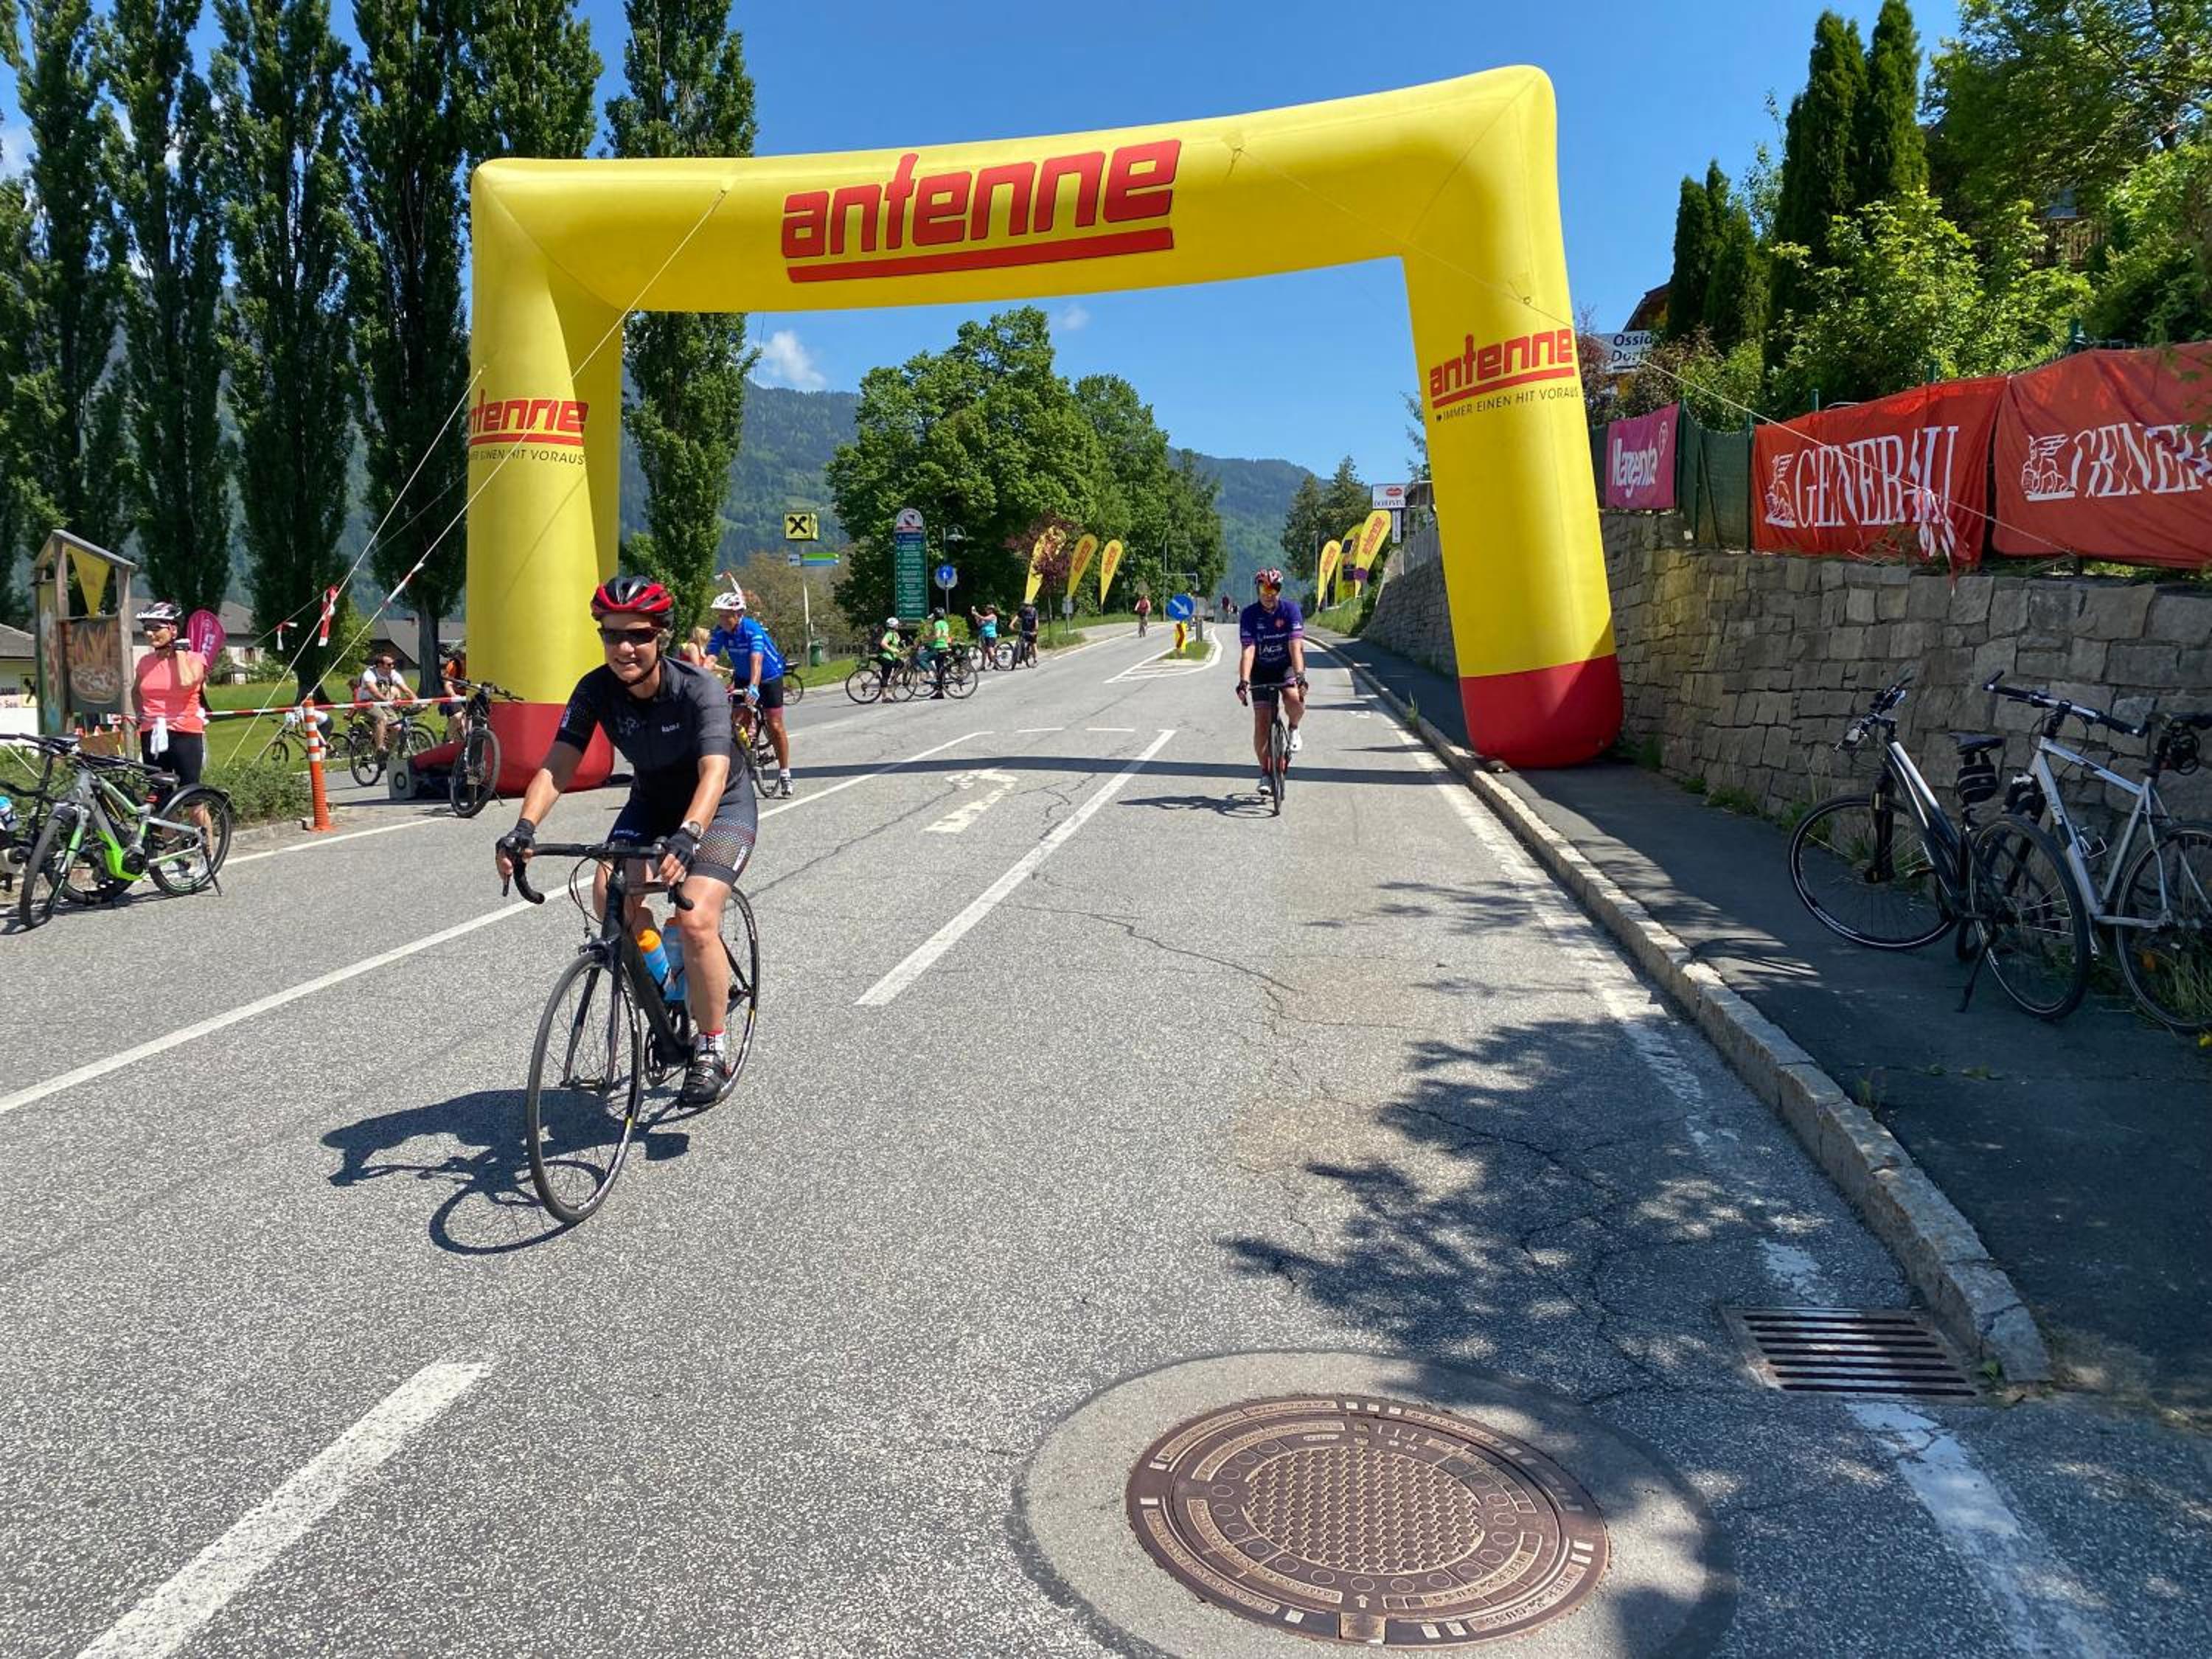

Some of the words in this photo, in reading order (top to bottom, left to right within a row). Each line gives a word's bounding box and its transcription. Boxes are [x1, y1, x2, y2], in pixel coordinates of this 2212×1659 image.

[782, 139, 1181, 259] antenne
[1430, 329, 1573, 397] antenne
[1443, 403, 1473, 421] IMMER
[1477, 394, 1511, 412] EINEN
[1516, 389, 1536, 404] HIT
[1540, 386, 1579, 400] VORAUS
[530, 449, 585, 465] VORAUS
